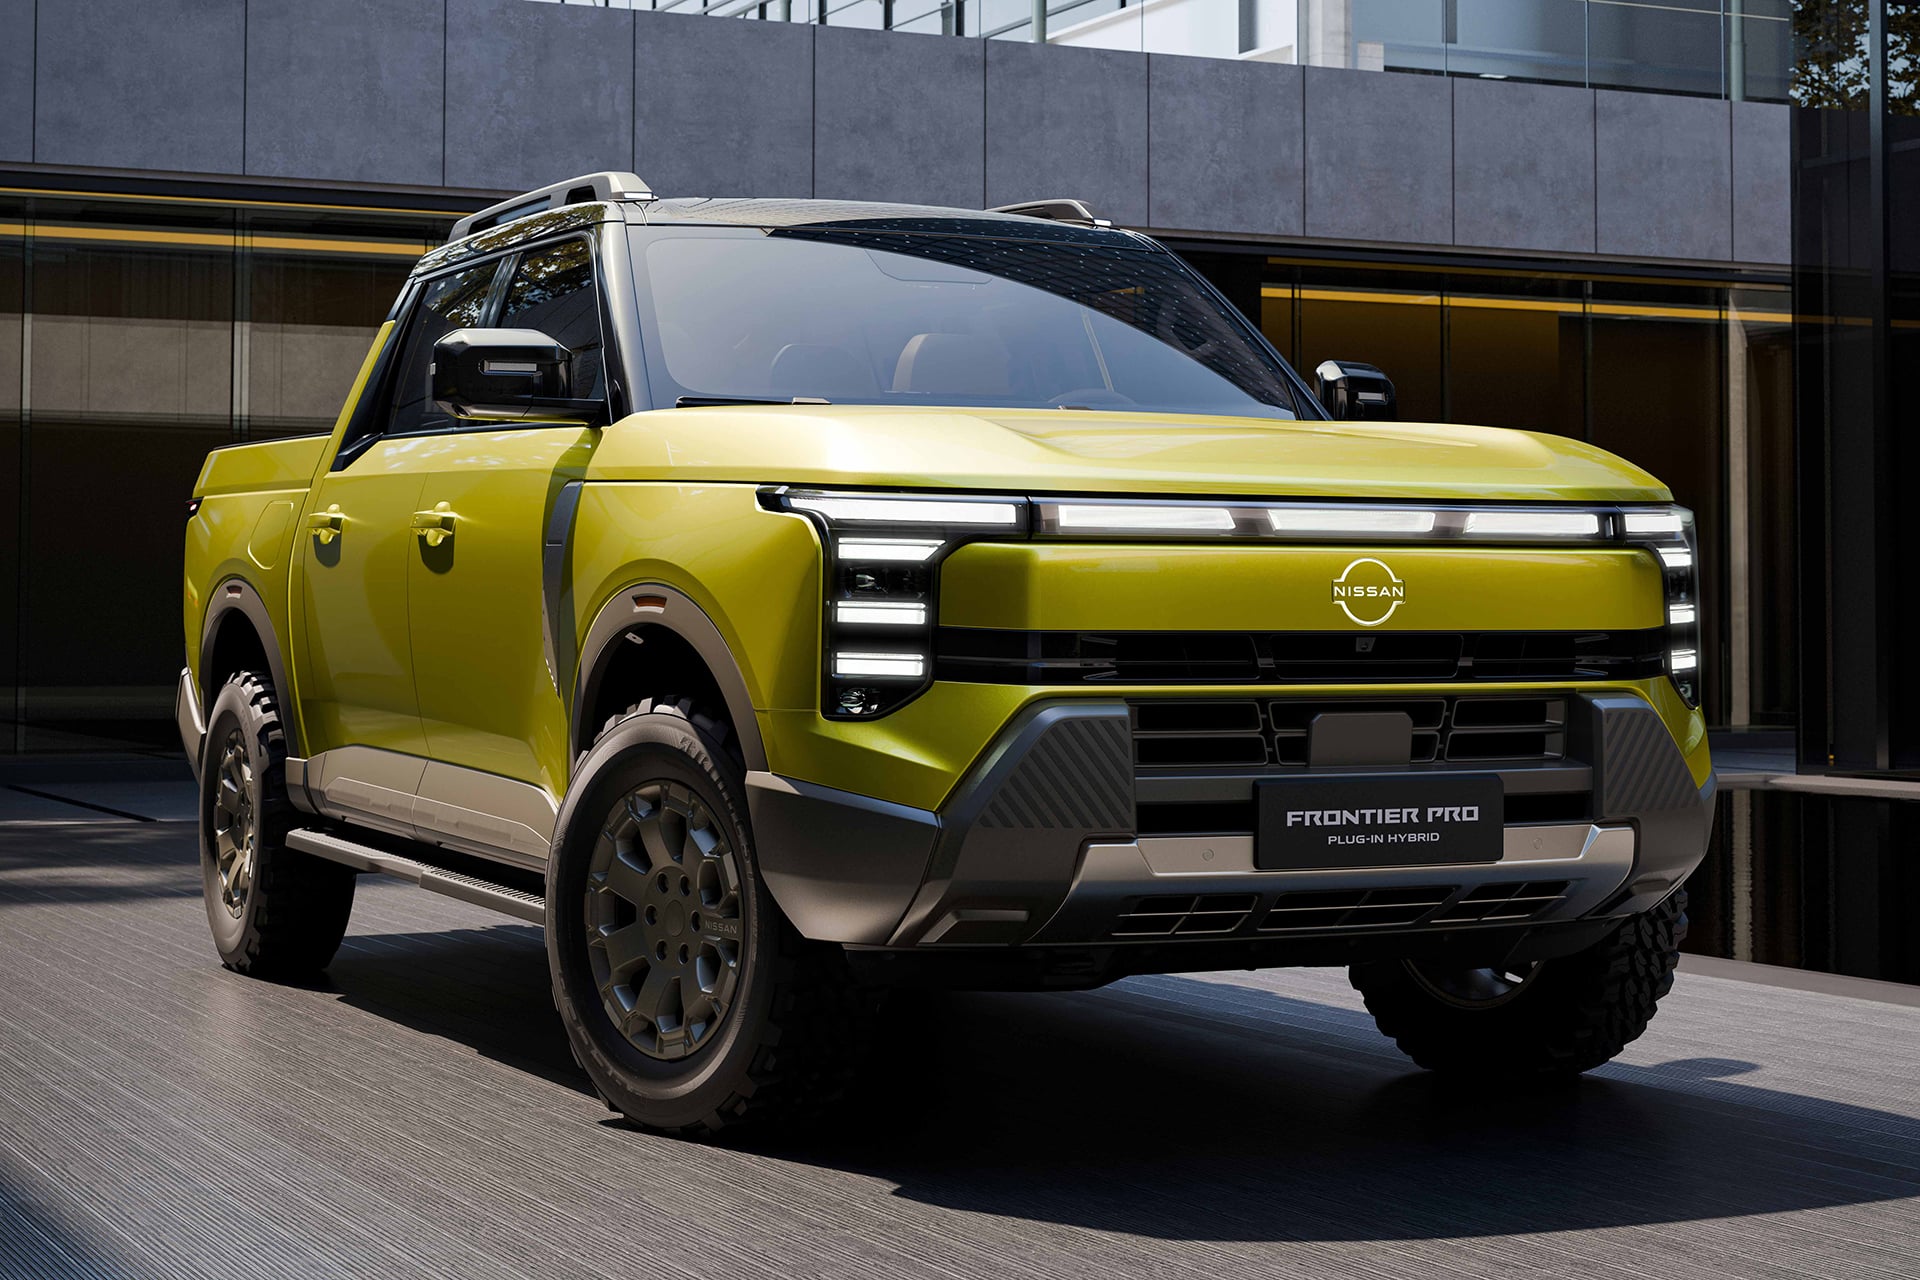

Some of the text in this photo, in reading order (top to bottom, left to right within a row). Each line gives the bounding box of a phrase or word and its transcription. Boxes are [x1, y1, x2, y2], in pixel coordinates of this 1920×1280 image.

[1333, 586, 1404, 597] NISSAN
[1286, 806, 1479, 827] FRONTIER PRO
[1328, 832, 1440, 845] PLUG-IN HYBRID
[704, 920, 737, 934] NISSAN
